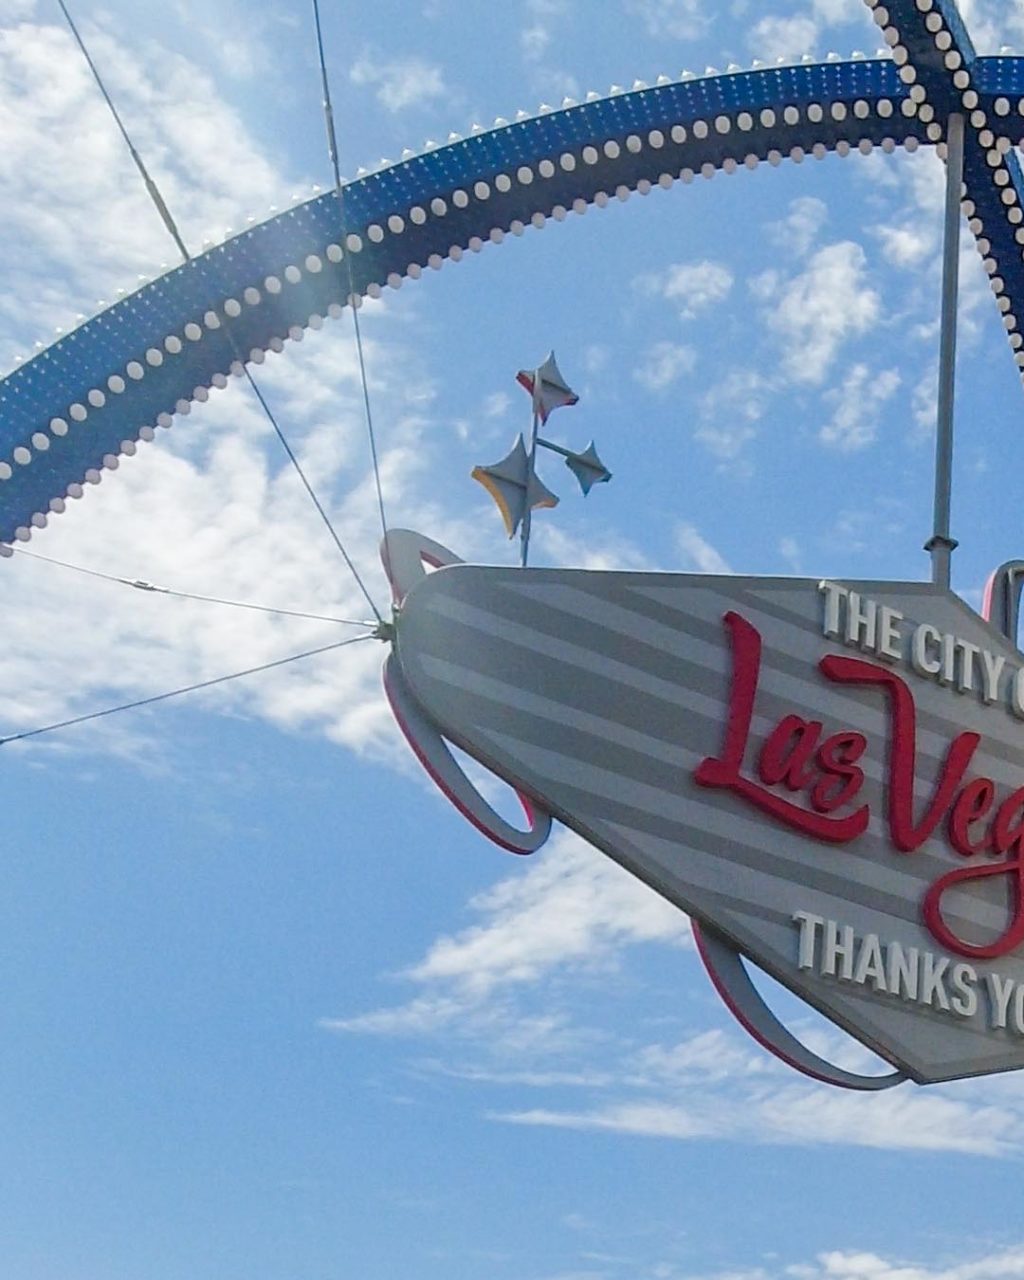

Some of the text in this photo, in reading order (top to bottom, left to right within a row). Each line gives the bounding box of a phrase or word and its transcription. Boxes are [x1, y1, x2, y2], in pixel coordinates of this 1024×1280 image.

[818, 580, 903, 662] THE
[911, 623, 1005, 705] CITY
[694, 610, 869, 843] Las
[792, 910, 978, 1017] THANKS
